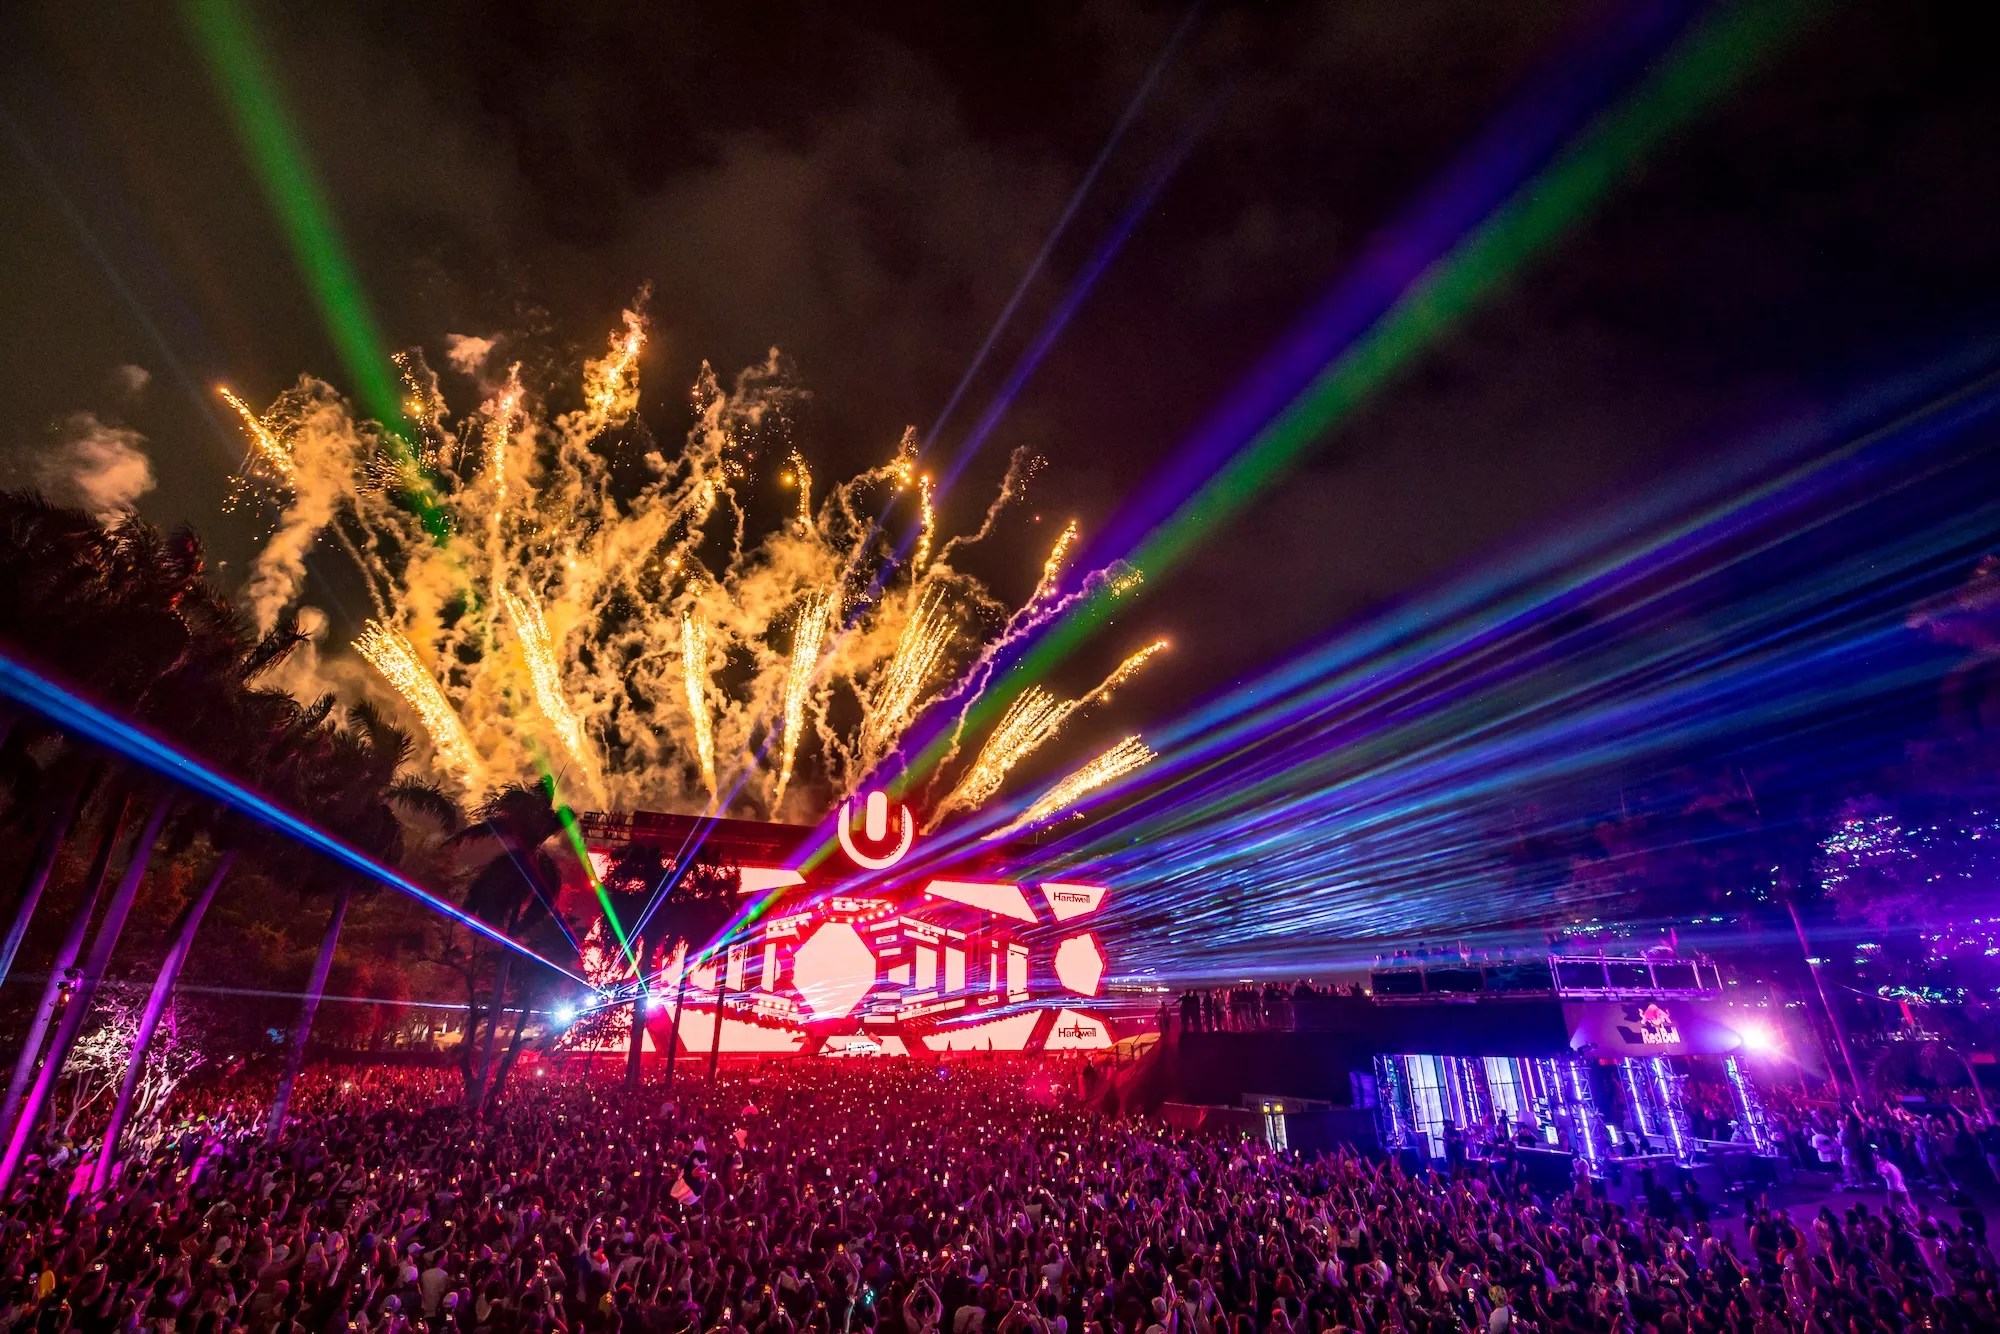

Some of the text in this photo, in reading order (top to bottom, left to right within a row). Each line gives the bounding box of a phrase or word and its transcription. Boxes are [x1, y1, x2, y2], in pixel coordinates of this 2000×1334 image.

[1053, 892, 1091, 904] Hardwell
[1640, 1025, 1681, 1045] Red Bull
